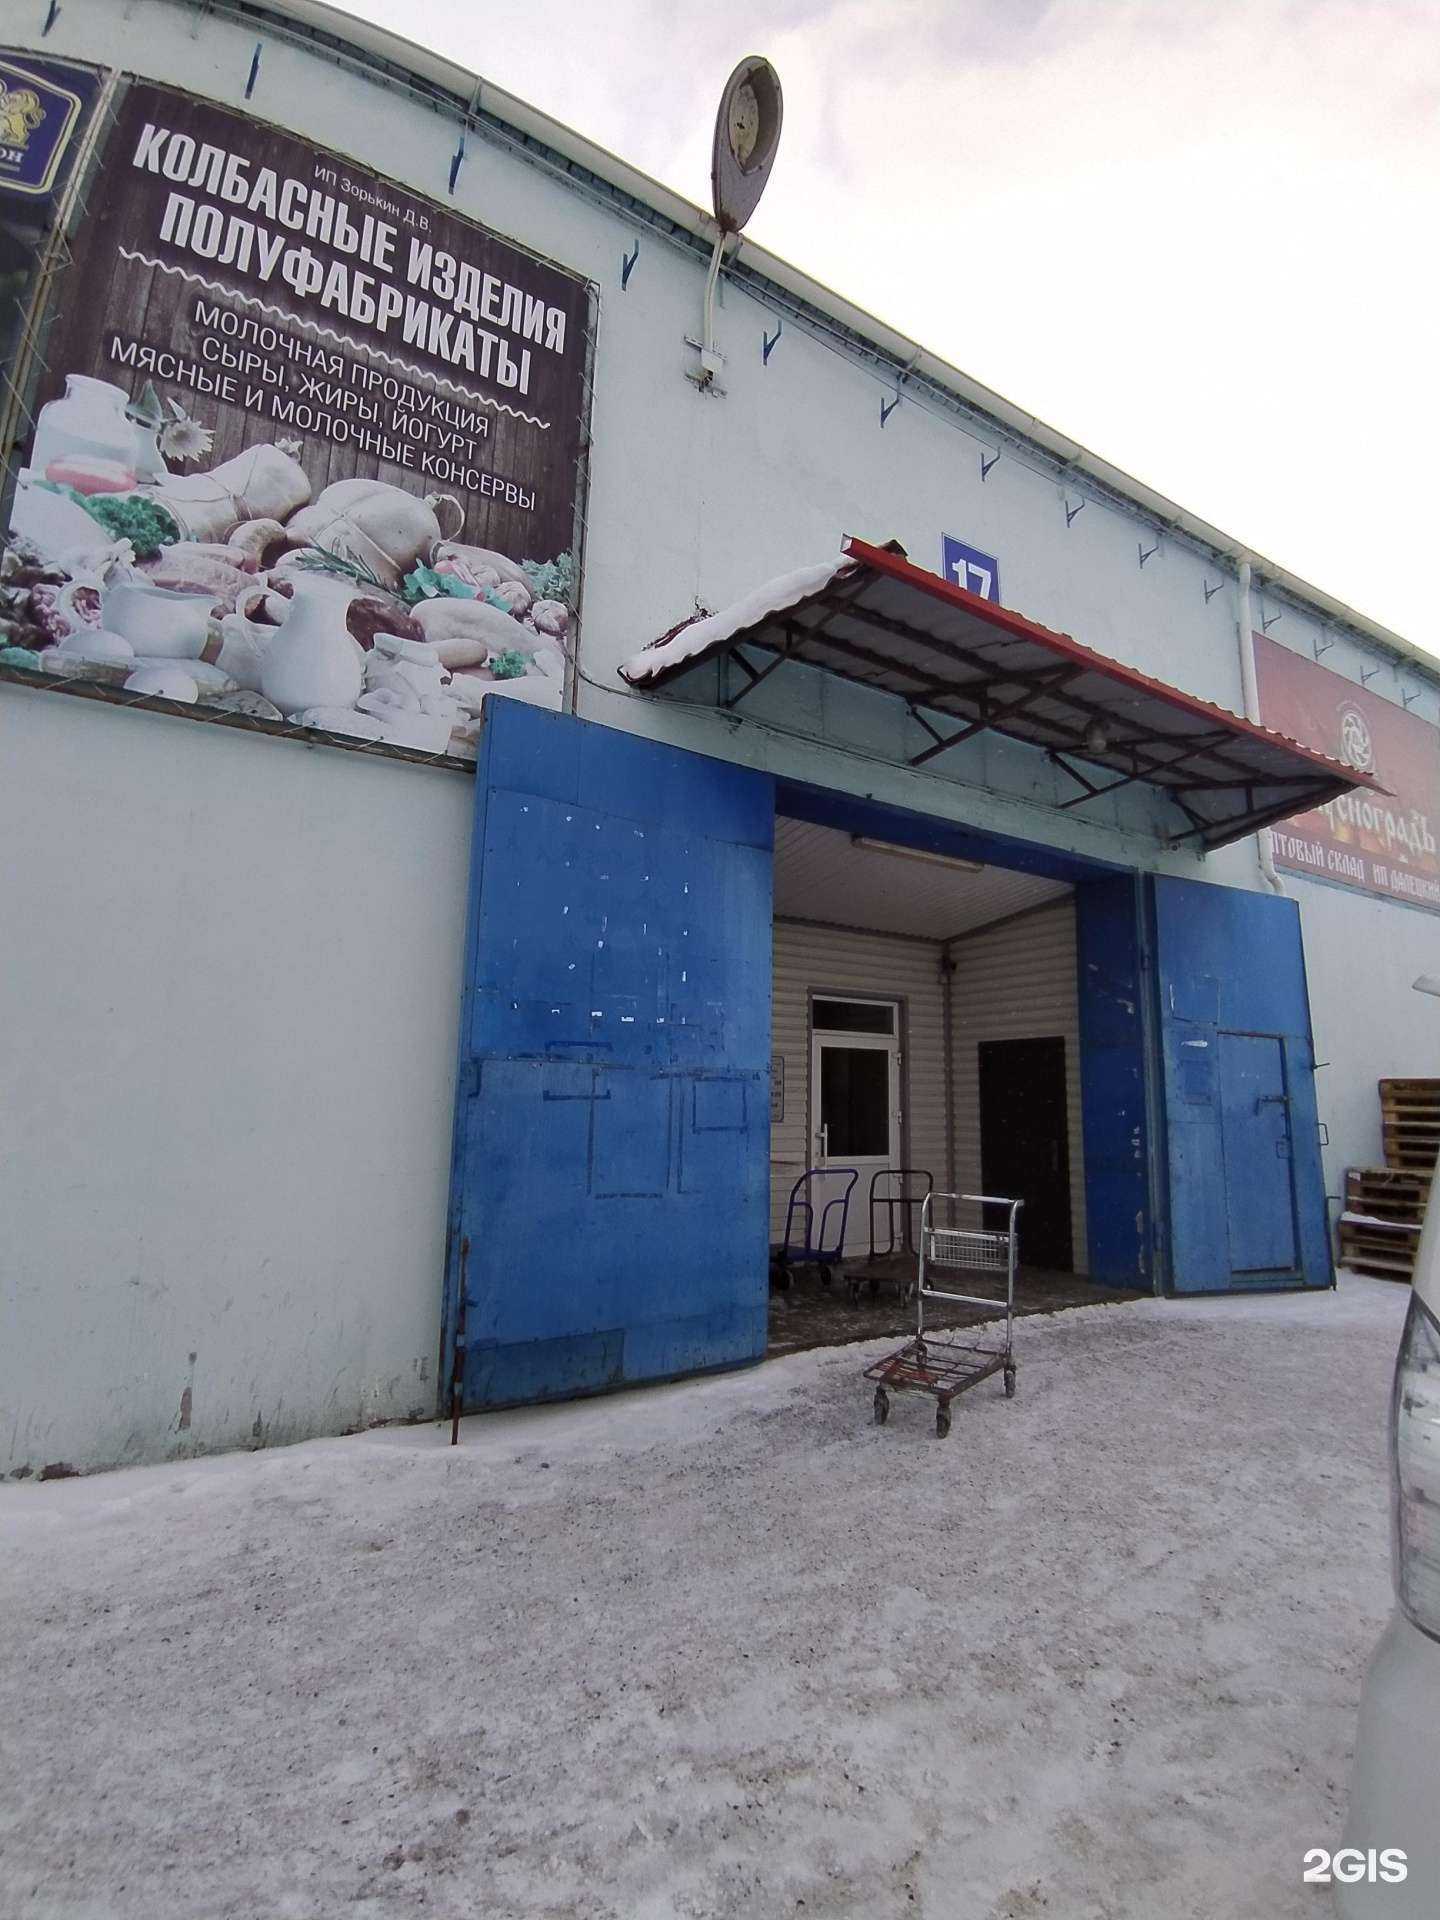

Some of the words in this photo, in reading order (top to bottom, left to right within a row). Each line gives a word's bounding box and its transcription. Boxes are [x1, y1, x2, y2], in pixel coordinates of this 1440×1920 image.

[132, 123, 398, 273] КОЛБАСНЫЕ
[406, 236, 567, 354] ИЗДЕЛИЯ
[314, 165, 337, 185] ИП
[341, 177, 400, 217] Зорькин
[403, 208, 433, 233] Д.В.
[159, 192, 532, 395] ПОЛУФАБРИКАТЫ
[111, 336, 239, 403] МЯСНЫЕ
[245, 385, 264, 412] И
[271, 395, 417, 468] МОЛОЧНЫЕ
[421, 451, 537, 511] КОНСЕРВЫ
[194, 300, 345, 379] МОЛОЧНАЯ
[351, 364, 489, 438] ПРОДУКЦИЯ
[202, 337, 290, 392] СЫРЫ,
[298, 373, 383, 428] ЖИРЫ,
[392, 405, 478, 460] ЙОГУРТ
[951, 558, 992, 601] 17
[1327, 850, 1366, 882] СКЛАД
